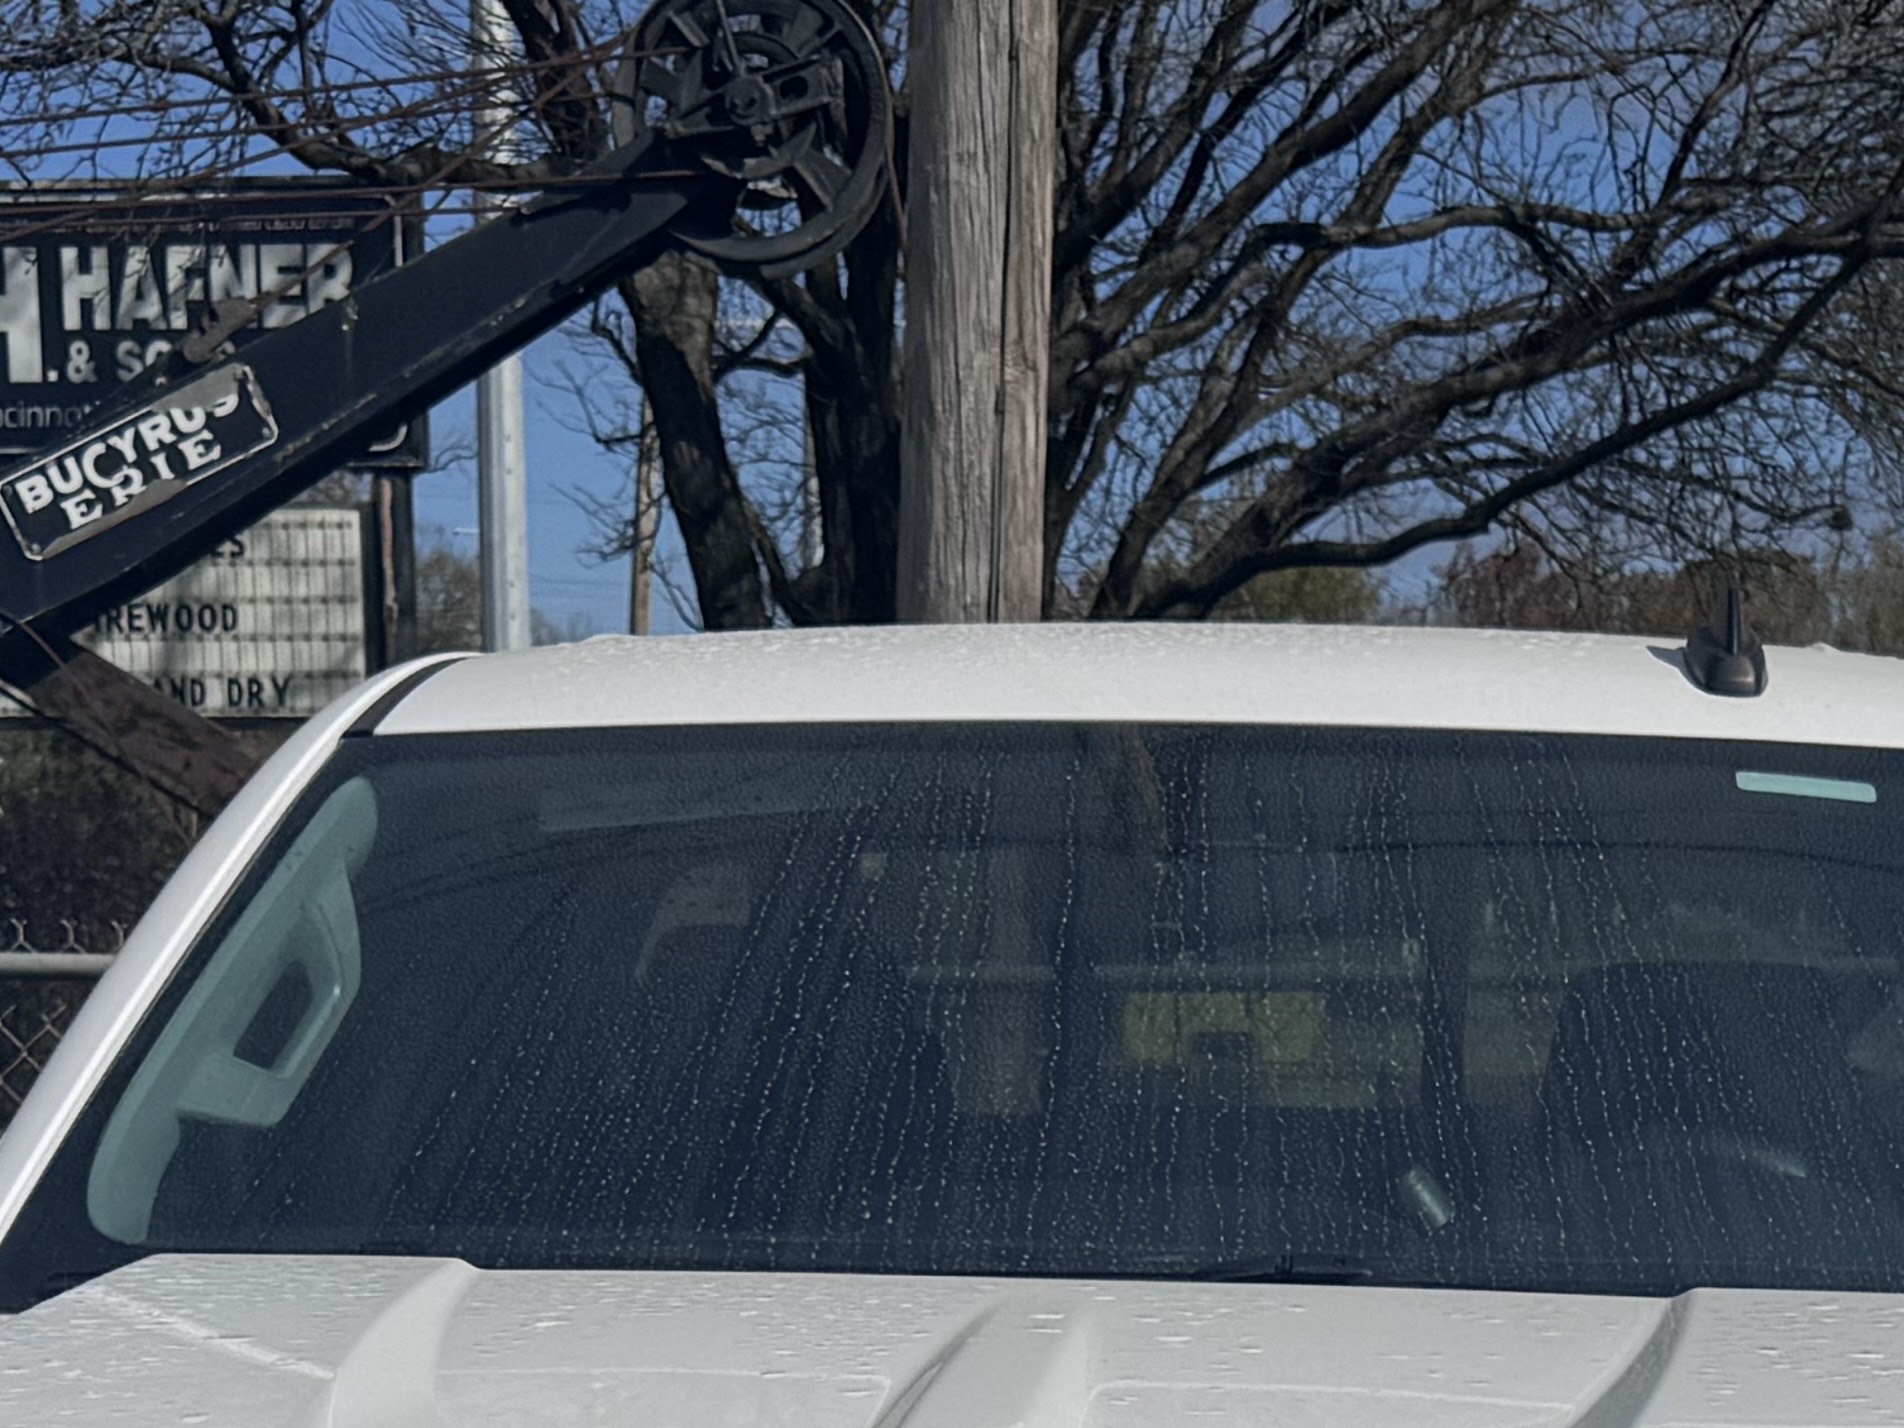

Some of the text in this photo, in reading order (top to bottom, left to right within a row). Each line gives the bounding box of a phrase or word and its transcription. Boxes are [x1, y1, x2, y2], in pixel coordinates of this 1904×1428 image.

[67, 341, 97, 383] &
[60, 429, 222, 530] ERIE
[227, 675, 291, 707] DRY
